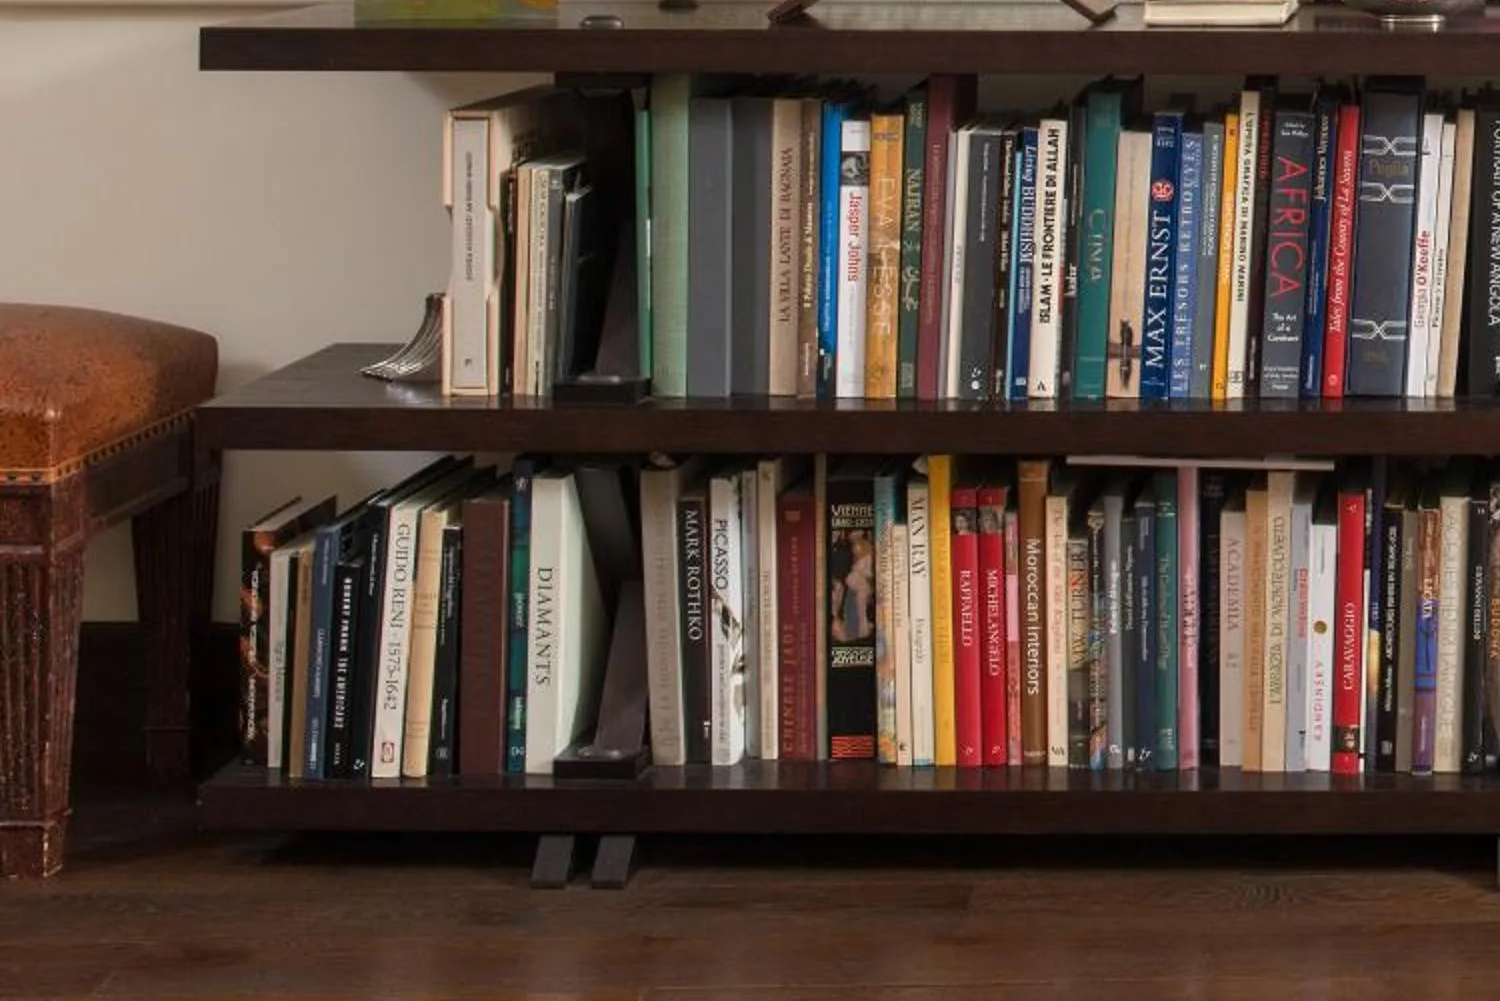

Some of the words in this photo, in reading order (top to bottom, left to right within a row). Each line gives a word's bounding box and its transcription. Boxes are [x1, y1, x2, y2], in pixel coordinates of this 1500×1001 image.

[1045, 175, 1056, 187] DI
[1046, 128, 1059, 172] ALLAH
[846, 191, 862, 236] Jasper
[877, 177, 896, 228] EVA
[1018, 186, 1035, 263] BUDDHISM
[1043, 190, 1056, 259] FRONTIERE
[1269, 155, 1309, 299] AFRICA
[846, 241, 861, 282] Johns
[1041, 262, 1052, 276] LE
[1151, 209, 1172, 299] ERNST
[1040, 285, 1051, 323] ISLAM
[1147, 306, 1168, 368] MAX
[684, 510, 701, 561] MARK
[911, 497, 926, 536] MAN
[393, 524, 410, 582] GUIDO
[713, 519, 728, 590] PICASSO
[911, 543, 925, 578] RAY
[1026, 538, 1042, 622] Moroccan
[391, 588, 405, 628] RENI
[535, 567, 553, 686] DIAMANTS
[687, 566, 703, 641] ROTHKO
[959, 569, 973, 647] RAFFAELLO
[985, 569, 1000, 676] MICHELANGELO
[383, 641, 401, 711] 1575-1642
[1027, 625, 1043, 696] Interiors
[1342, 602, 1355, 690] CARAVAGGIO
